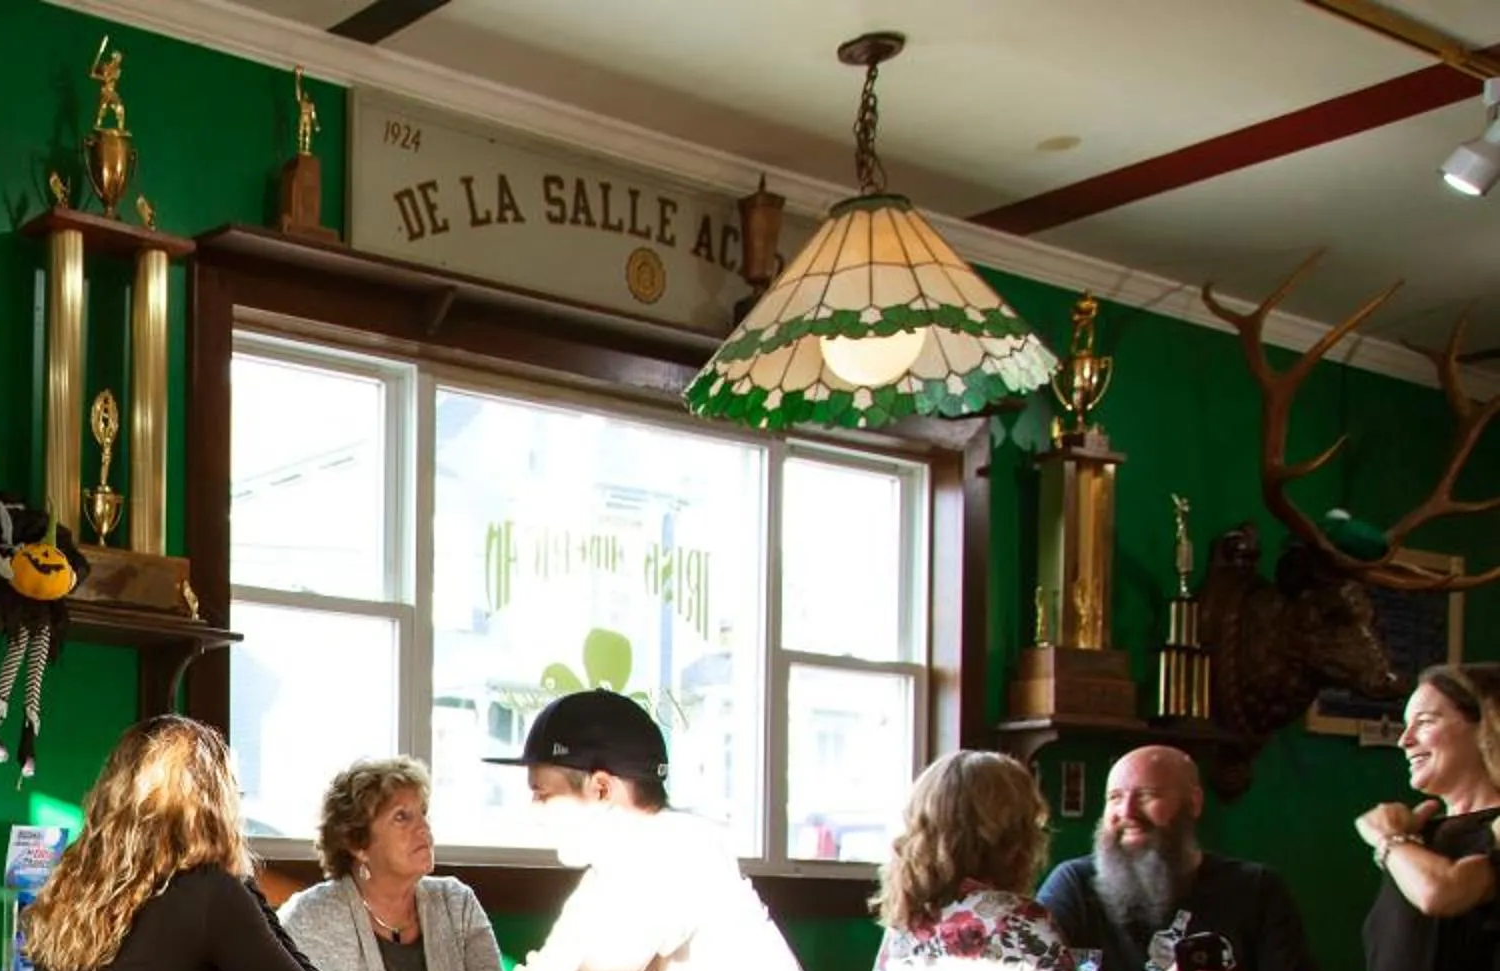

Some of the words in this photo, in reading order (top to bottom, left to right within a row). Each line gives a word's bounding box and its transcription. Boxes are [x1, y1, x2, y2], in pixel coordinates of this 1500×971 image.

[383, 120, 422, 153] 1924
[394, 180, 449, 243] DE
[460, 174, 526, 227] LA
[542, 174, 679, 247] SALLE
